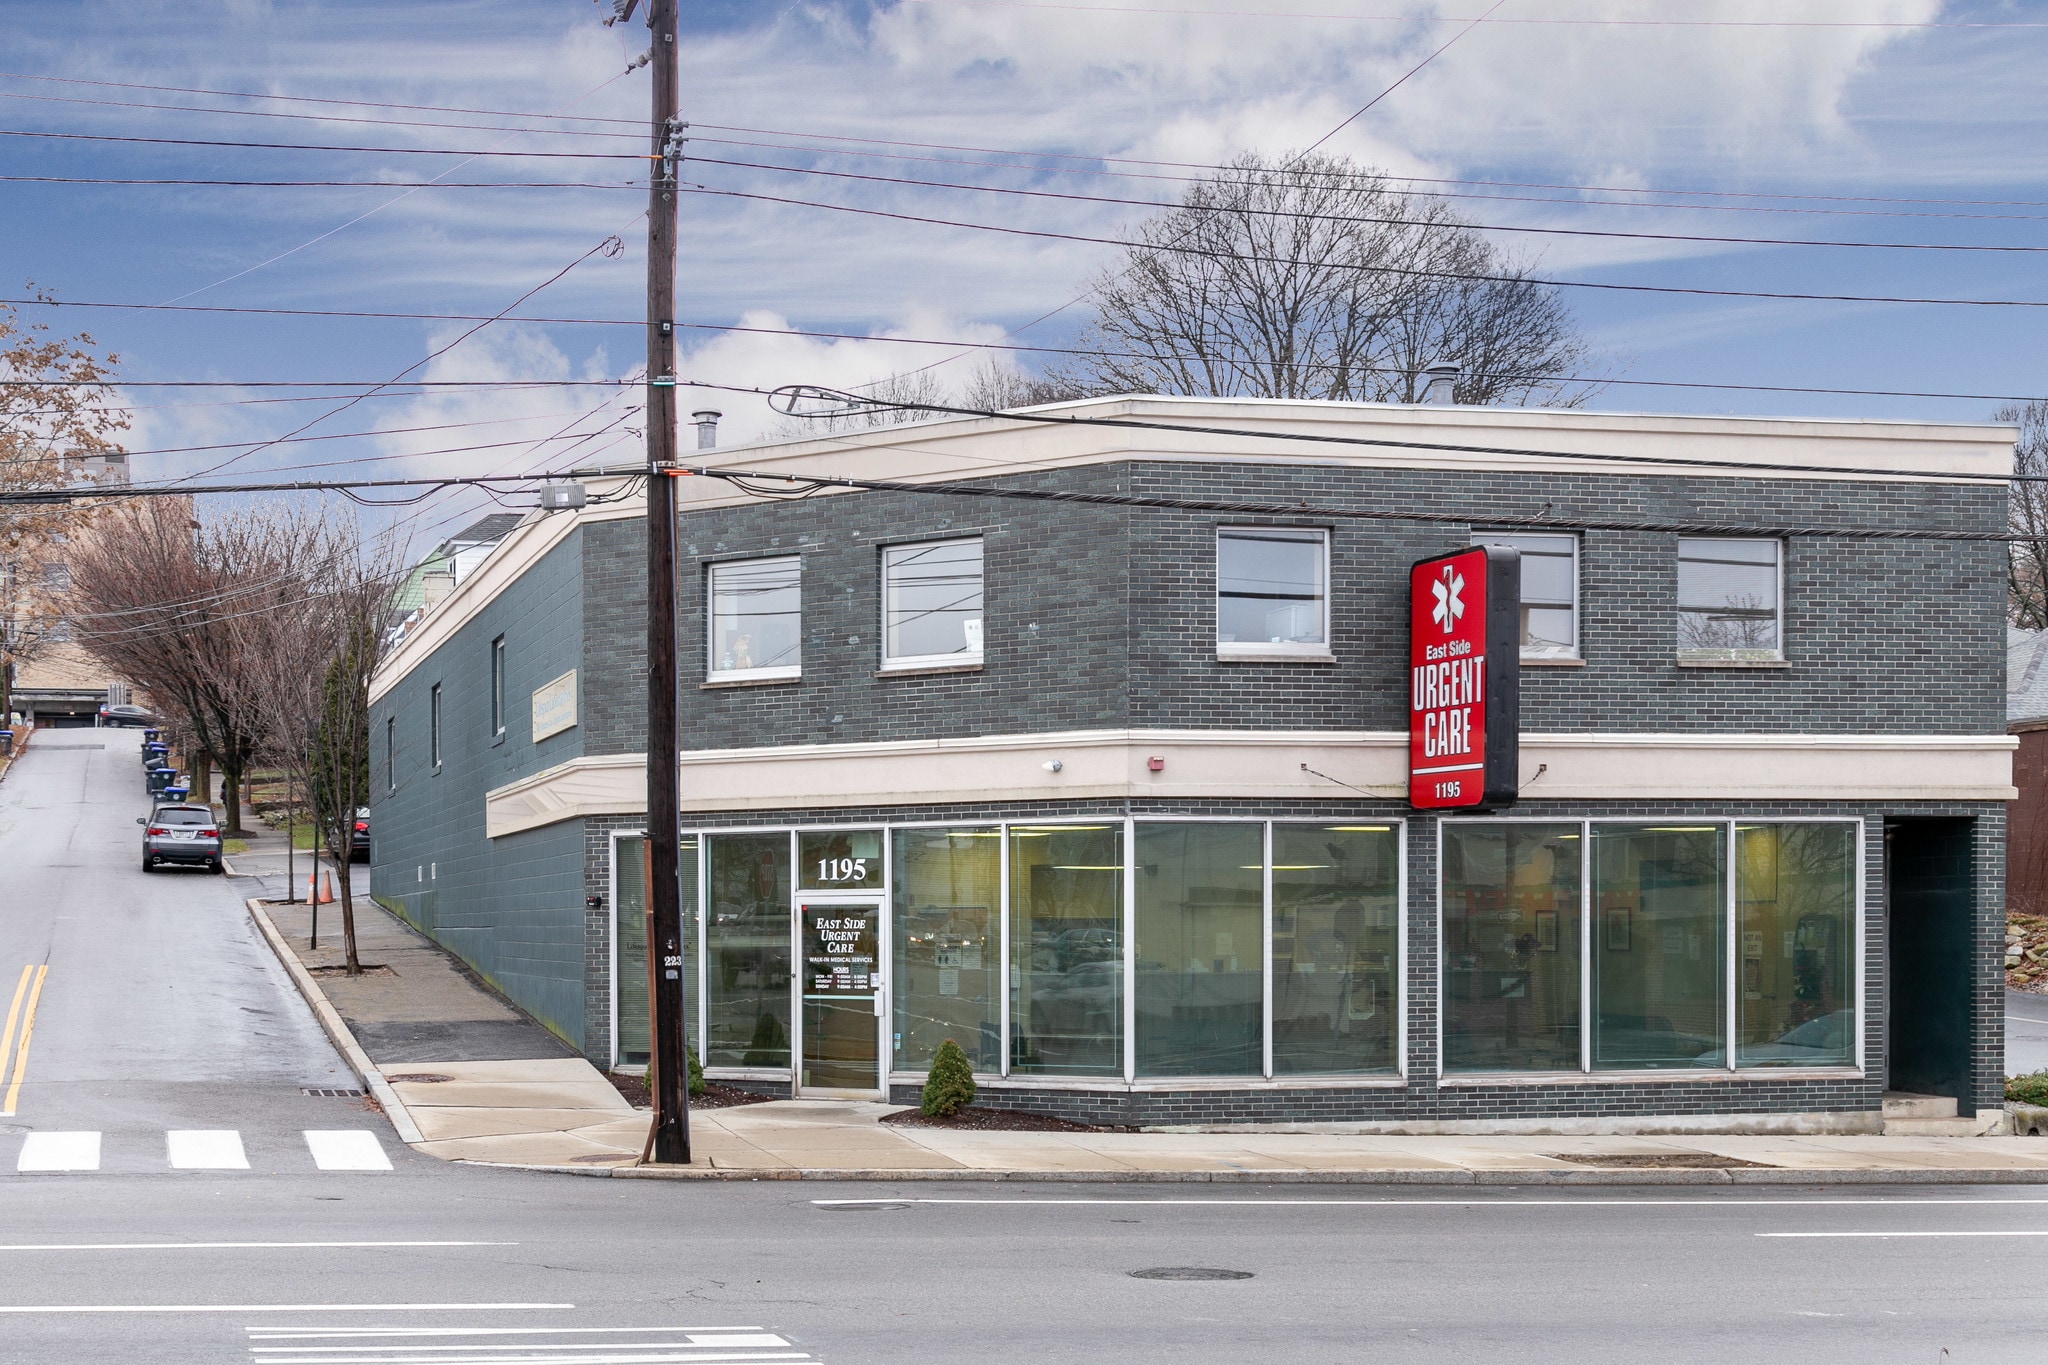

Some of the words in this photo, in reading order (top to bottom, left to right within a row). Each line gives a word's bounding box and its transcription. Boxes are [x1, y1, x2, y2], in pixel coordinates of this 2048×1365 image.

[1426, 643, 1448, 661] East
[1449, 638, 1471, 658] Side
[1413, 655, 1484, 712] URGENT
[1424, 707, 1472, 758] CARE
[1434, 780, 1461, 800] 1195
[818, 858, 866, 881] 1195
[816, 918, 841, 929] EAST
[843, 917, 866, 929] SIDE
[821, 930, 861, 941] URGENT
[827, 941, 854, 953] CARE
[664, 955, 682, 967] 223
